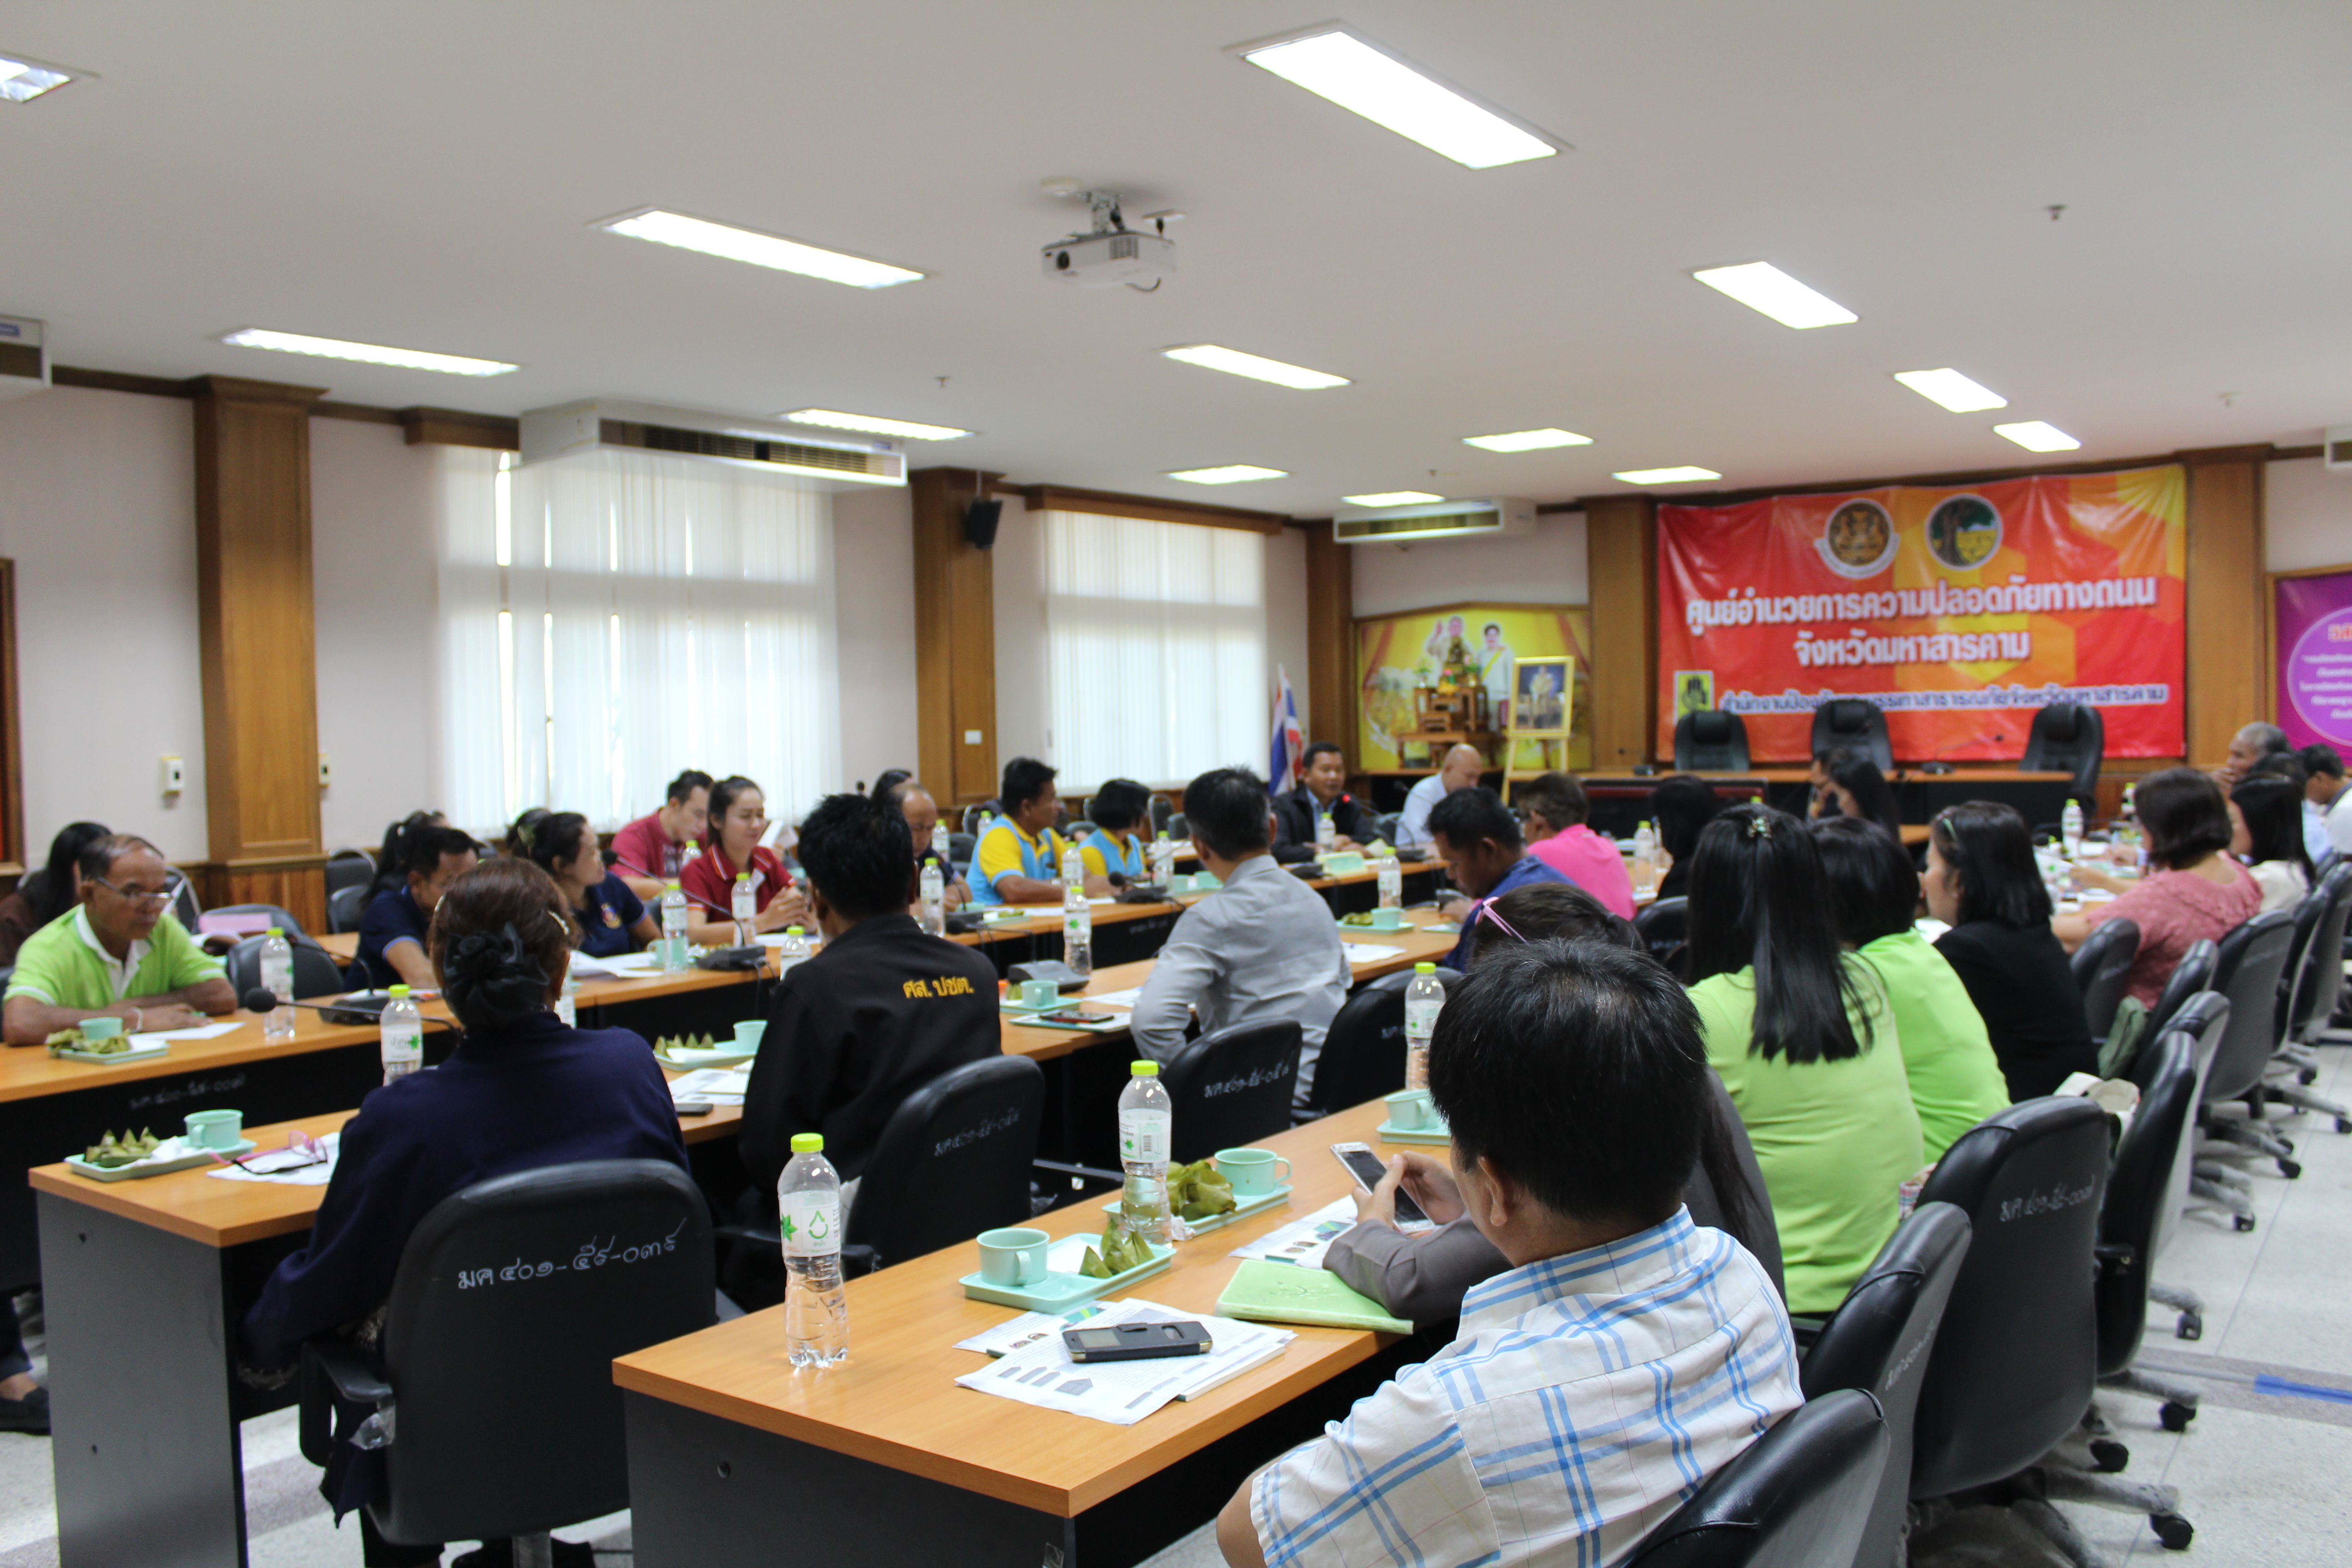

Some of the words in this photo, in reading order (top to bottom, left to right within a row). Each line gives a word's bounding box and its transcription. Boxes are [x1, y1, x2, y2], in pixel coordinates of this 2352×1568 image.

[1686, 574, 2157, 636] ศูนย์อำนวยการความปลอดภัยทางถนน
[1793, 628, 2030, 666] จังหวัดมหาสารคาม
[458, 1269, 494, 1289] มค
